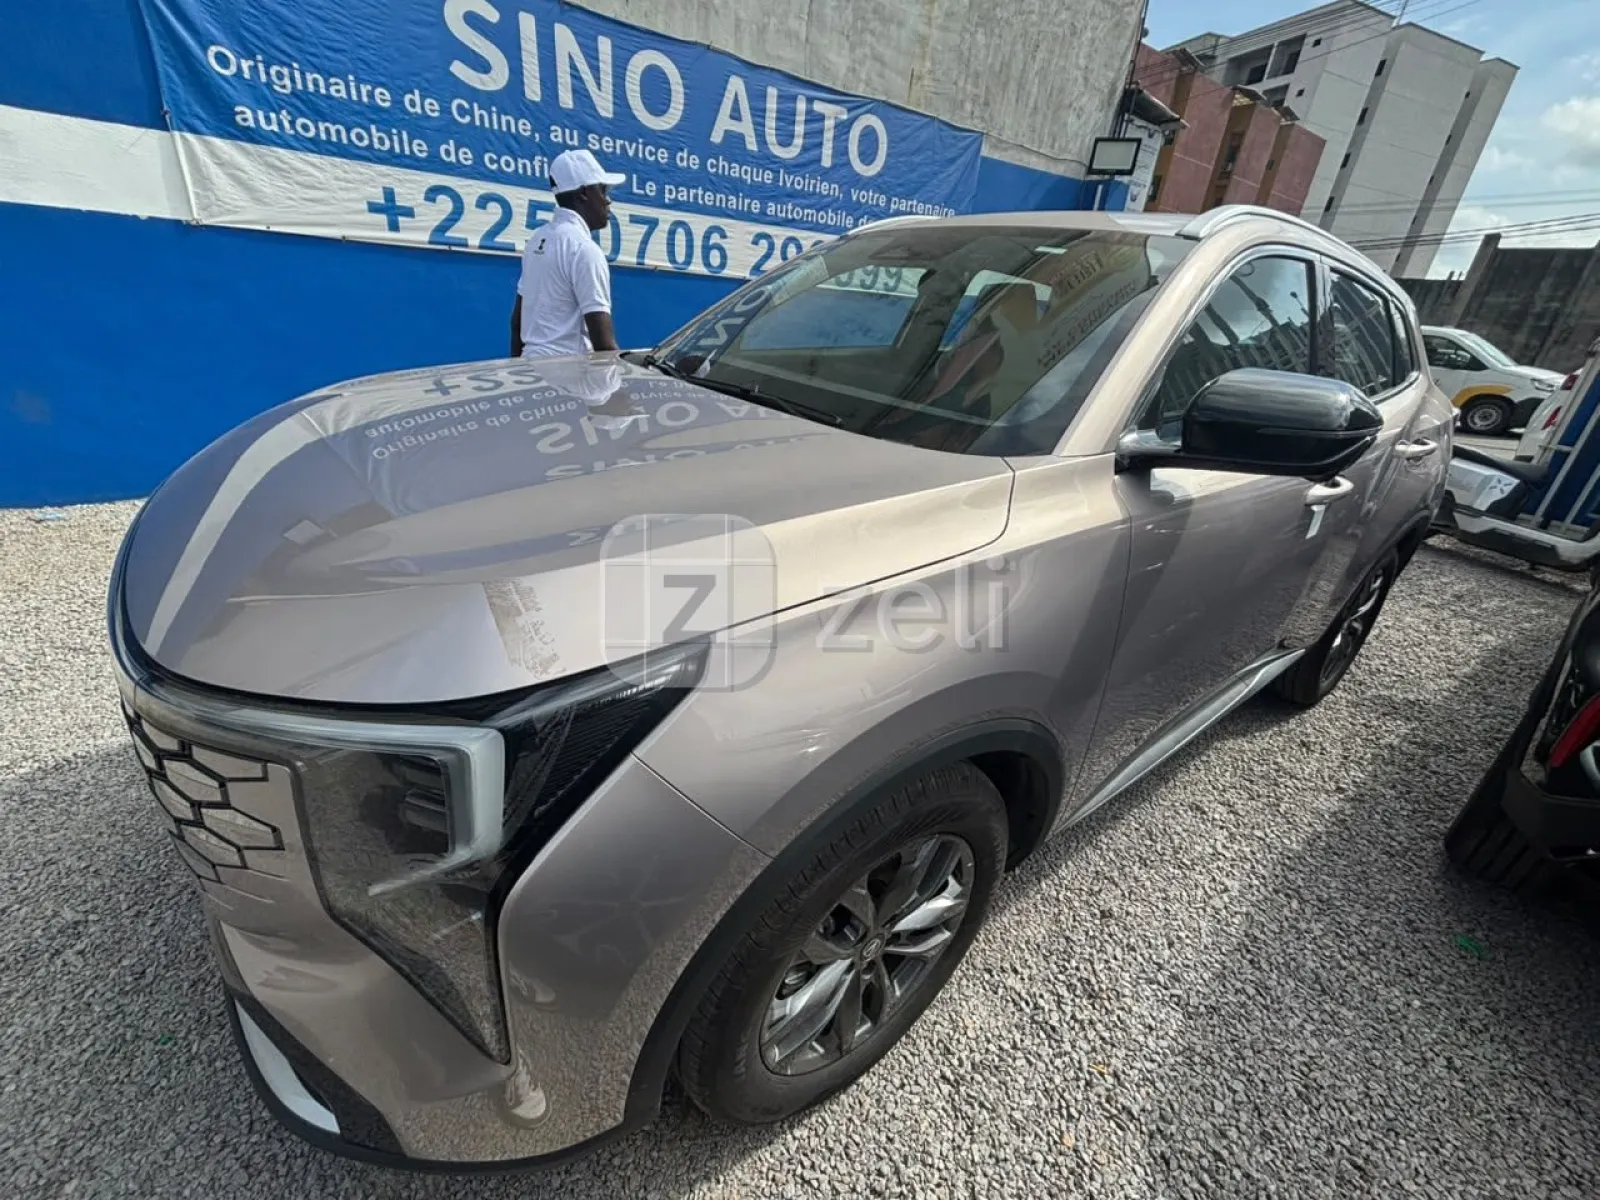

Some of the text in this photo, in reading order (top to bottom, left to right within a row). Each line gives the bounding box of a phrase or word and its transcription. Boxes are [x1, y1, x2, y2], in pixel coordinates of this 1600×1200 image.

[207, 44, 955, 218] Originaire de Chine, au service de chaque Ivoirien, votre partenaire
[444, 0, 888, 176] SINO AUTO
[234, 105, 429, 157] automobile
[440, 140, 473, 165] de
[484, 151, 550, 179] confi
[632, 174, 656, 196] Le
[665, 184, 761, 213] partenaire
[767, 202, 854, 228] automobile
[367, 184, 557, 251] +225
[591, 210, 728, 275] 0706
